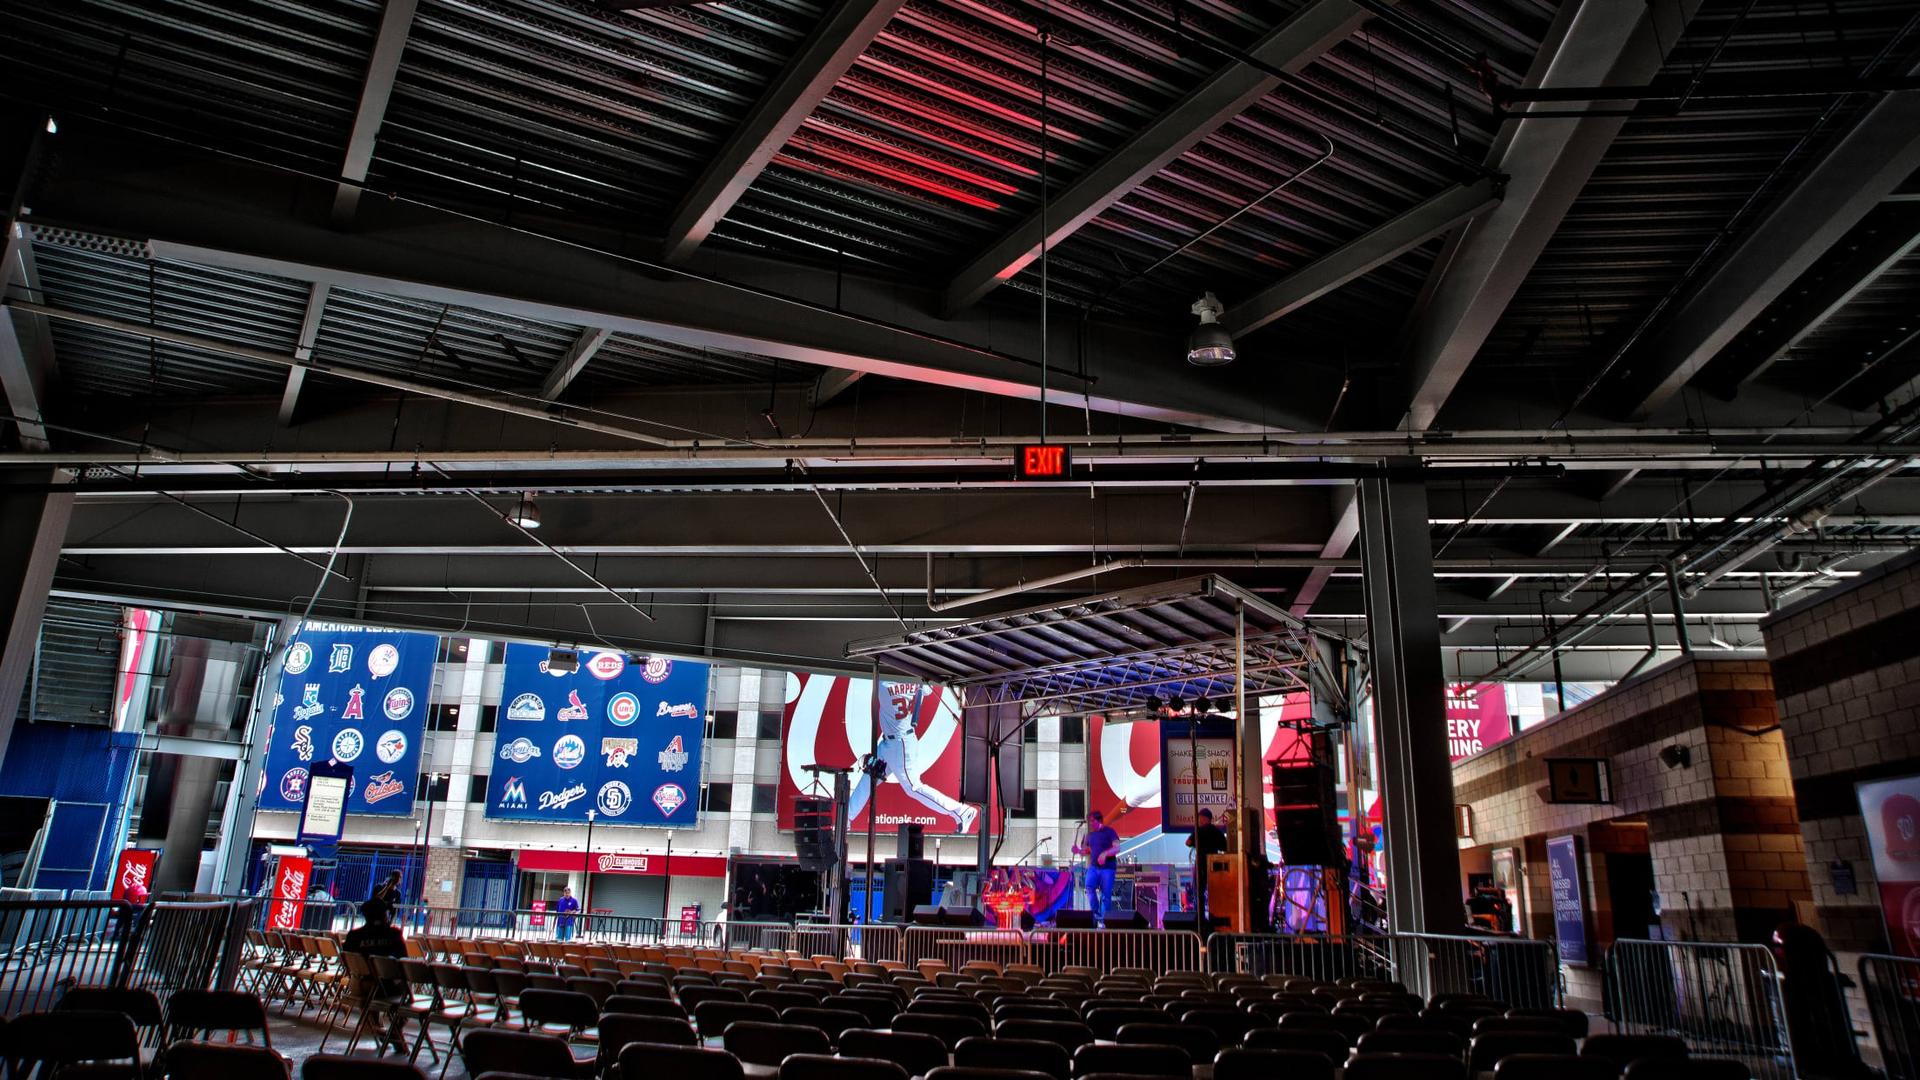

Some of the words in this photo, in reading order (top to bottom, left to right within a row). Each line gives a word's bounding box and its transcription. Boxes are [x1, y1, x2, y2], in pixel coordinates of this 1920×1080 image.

[1024, 446, 1064, 475] EXIT
[596, 660, 623, 670] REDS
[1447, 719, 1480, 737] ERY
[1207, 749, 1230, 757] SHACK
[538, 783, 588, 811] Dodgers
[1177, 793, 1194, 803] BLU
[1199, 793, 1226, 803] SMOKE
[875, 813, 936, 825] ationals.com
